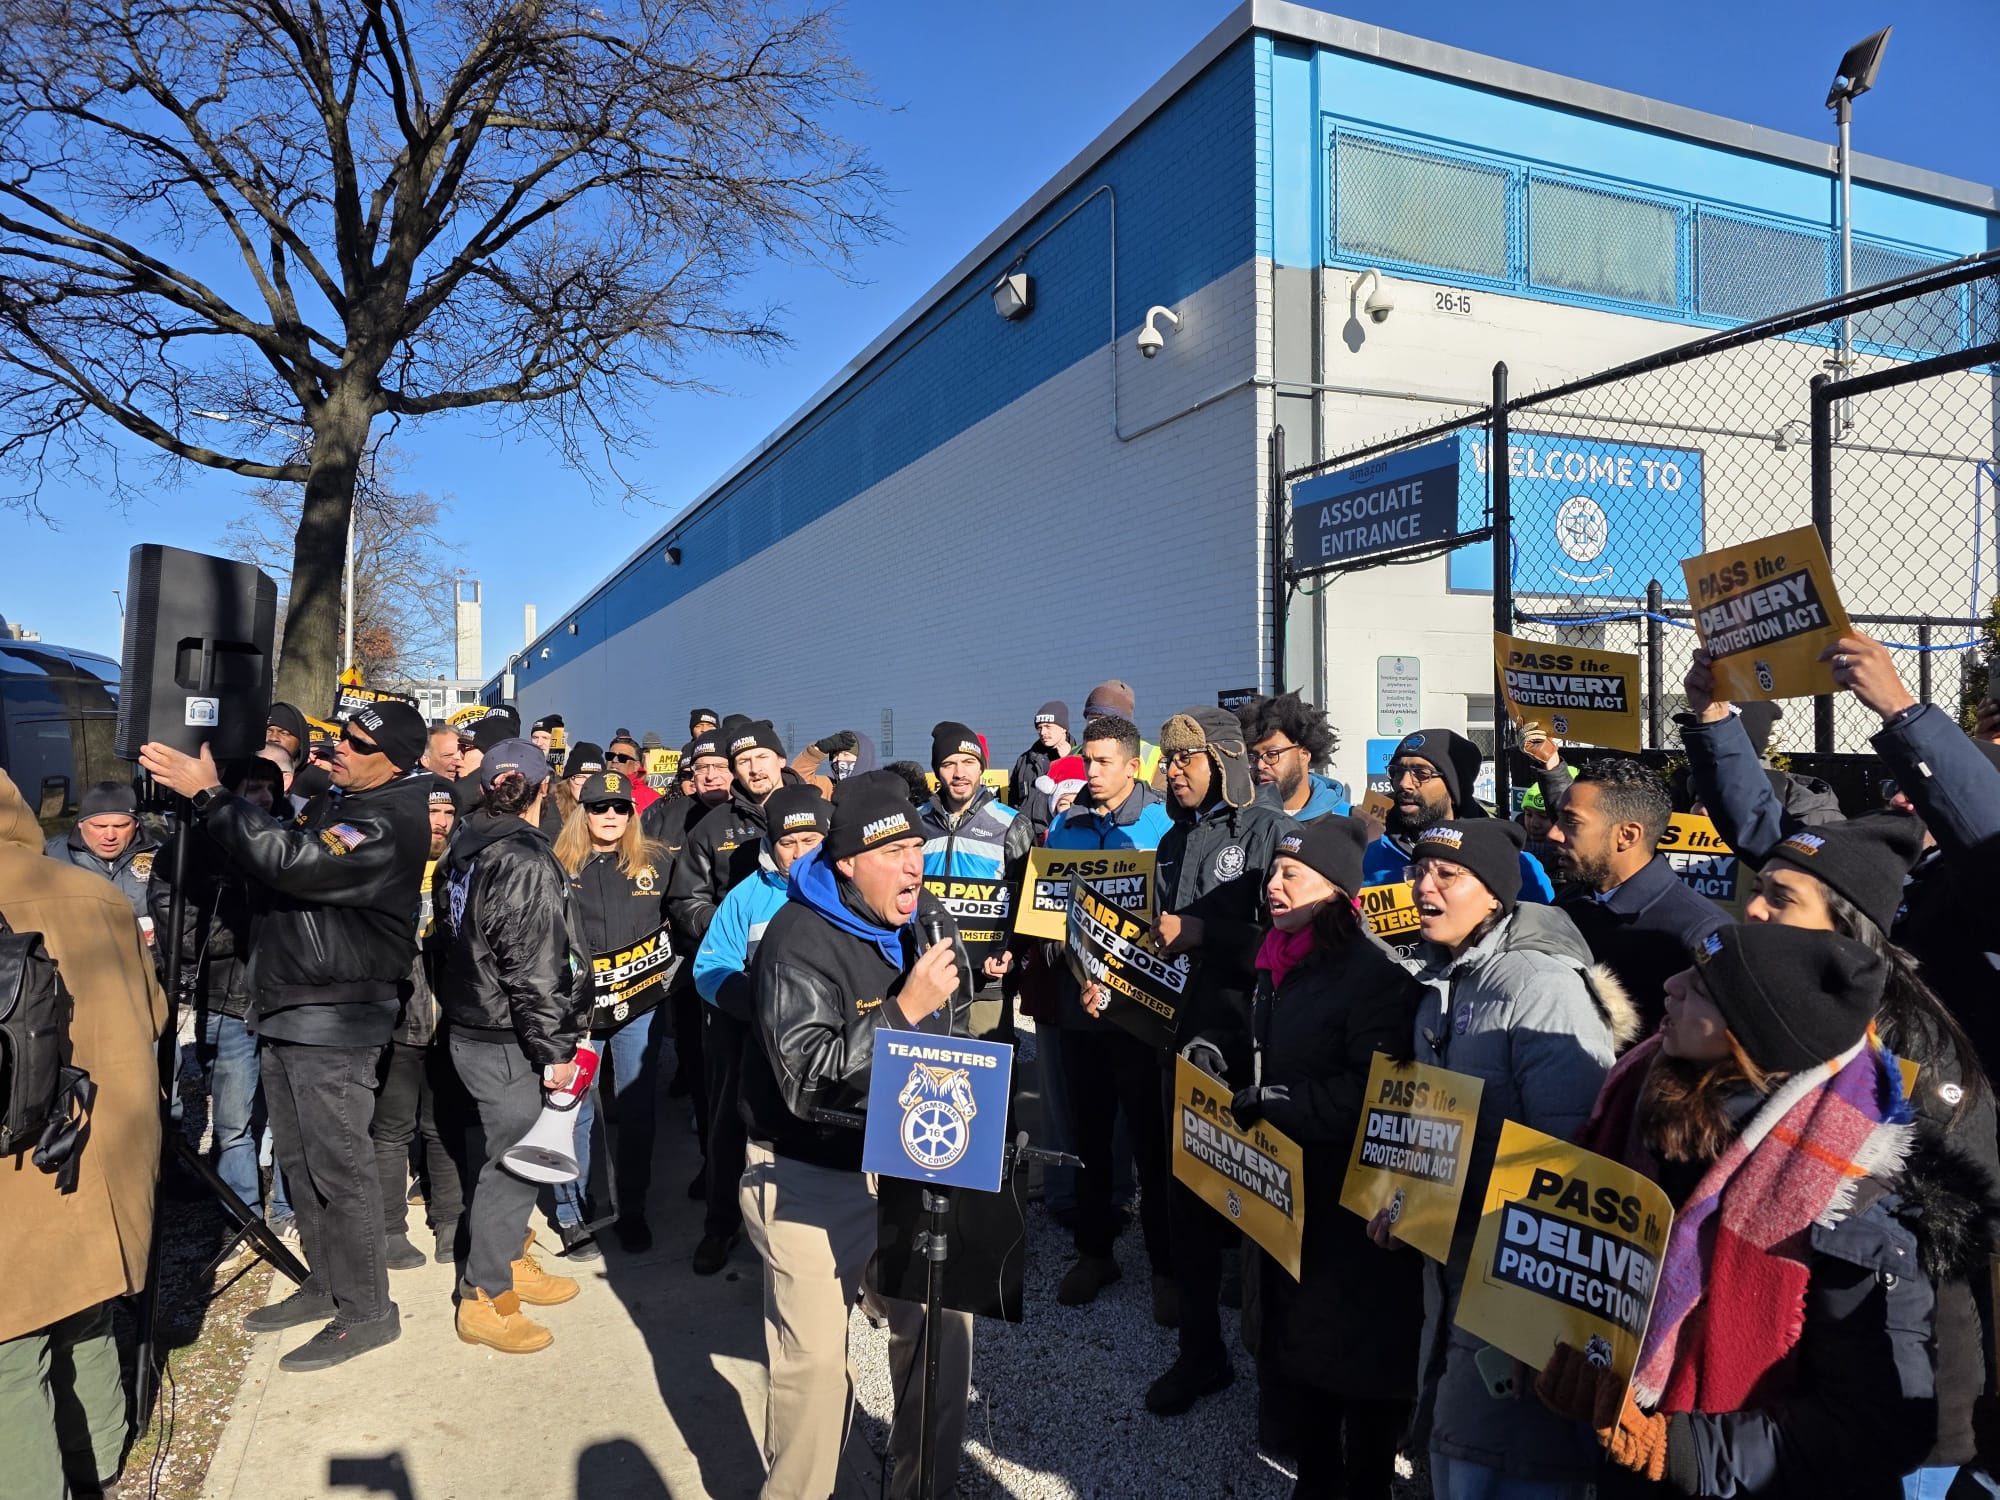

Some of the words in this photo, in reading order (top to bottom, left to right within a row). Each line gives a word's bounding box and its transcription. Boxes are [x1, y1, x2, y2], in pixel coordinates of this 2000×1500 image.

[1435, 291, 1471, 314] 26-15
[1348, 460, 1388, 484] amazon
[1471, 441, 1635, 488] WELCOME
[1641, 459, 1683, 492] TO
[1319, 480, 1424, 529] ASSOCIATE
[1321, 512, 1422, 557] ENTRANCE
[1698, 560, 1750, 600] PASS
[1753, 555, 1787, 580] the
[1699, 574, 1808, 636] DELIVERY
[1706, 616, 1784, 657] PROTECTION
[1783, 602, 1821, 633] ACT
[1508, 651, 1574, 671] PASS
[1579, 659, 1611, 673] the
[342, 687, 376, 702] FAIR
[1504, 670, 1622, 695] DELIVERY
[1507, 687, 1591, 708] PROTECTION
[1593, 696, 1624, 710] ACT
[358, 709, 384, 731] CLUB
[453, 709, 485, 725] PASS
[784, 812, 815, 825] AMAZON
[862, 812, 906, 838] AMAZON
[863, 822, 911, 846] TEAMSTERS
[971, 826, 993, 838] amazon
[1687, 831, 1724, 848] the
[1046, 859, 1108, 877] PASS
[1113, 861, 1137, 874] the
[924, 881, 947, 898] IR
[949, 883, 996, 901] PAY
[997, 886, 1011, 902] &
[1036, 876, 1145, 898] DEVERY
[950, 902, 1006, 916] JOBS
[1120, 894, 1145, 909] ACT
[1074, 885, 1120, 933] FAIR
[1121, 919, 1151, 948] PA
[1173, 952, 1191, 974] &
[615, 936, 657, 968] PAY
[658, 930, 669, 947] &
[1073, 906, 1116, 949] SAFE
[1120, 945, 1183, 988] JOBS
[619, 946, 669, 978] JOBS
[1069, 930, 1109, 983] AMAZON
[1107, 972, 1172, 1018] TEAMSTERS
[1103, 951, 1124, 971] for
[610, 980, 630, 992] for
[887, 1042, 998, 1069] TEAMSTERS
[1379, 1079, 1430, 1109] PASS
[1432, 1089, 1457, 1113] the
[914, 1101, 961, 1124] TEAMSTERS
[928, 1128, 941, 1138] 16
[1254, 1129, 1279, 1157] the
[1366, 1112, 1462, 1153] DELIVERY
[907, 1139, 926, 1162] JOINT
[927, 1145, 961, 1165] COUNCIL
[1184, 1108, 1289, 1190] DELIVERY
[1362, 1141, 1431, 1175] PROTECTION
[1430, 1155, 1456, 1180] ACT
[1184, 1133, 1262, 1195] PROTECTION
[1264, 1183, 1291, 1213] ACT
[1526, 1167, 1642, 1234] PASS
[1504, 1207, 1656, 1301] DELIVER
[1499, 1246, 1641, 1328] PROTECTION
